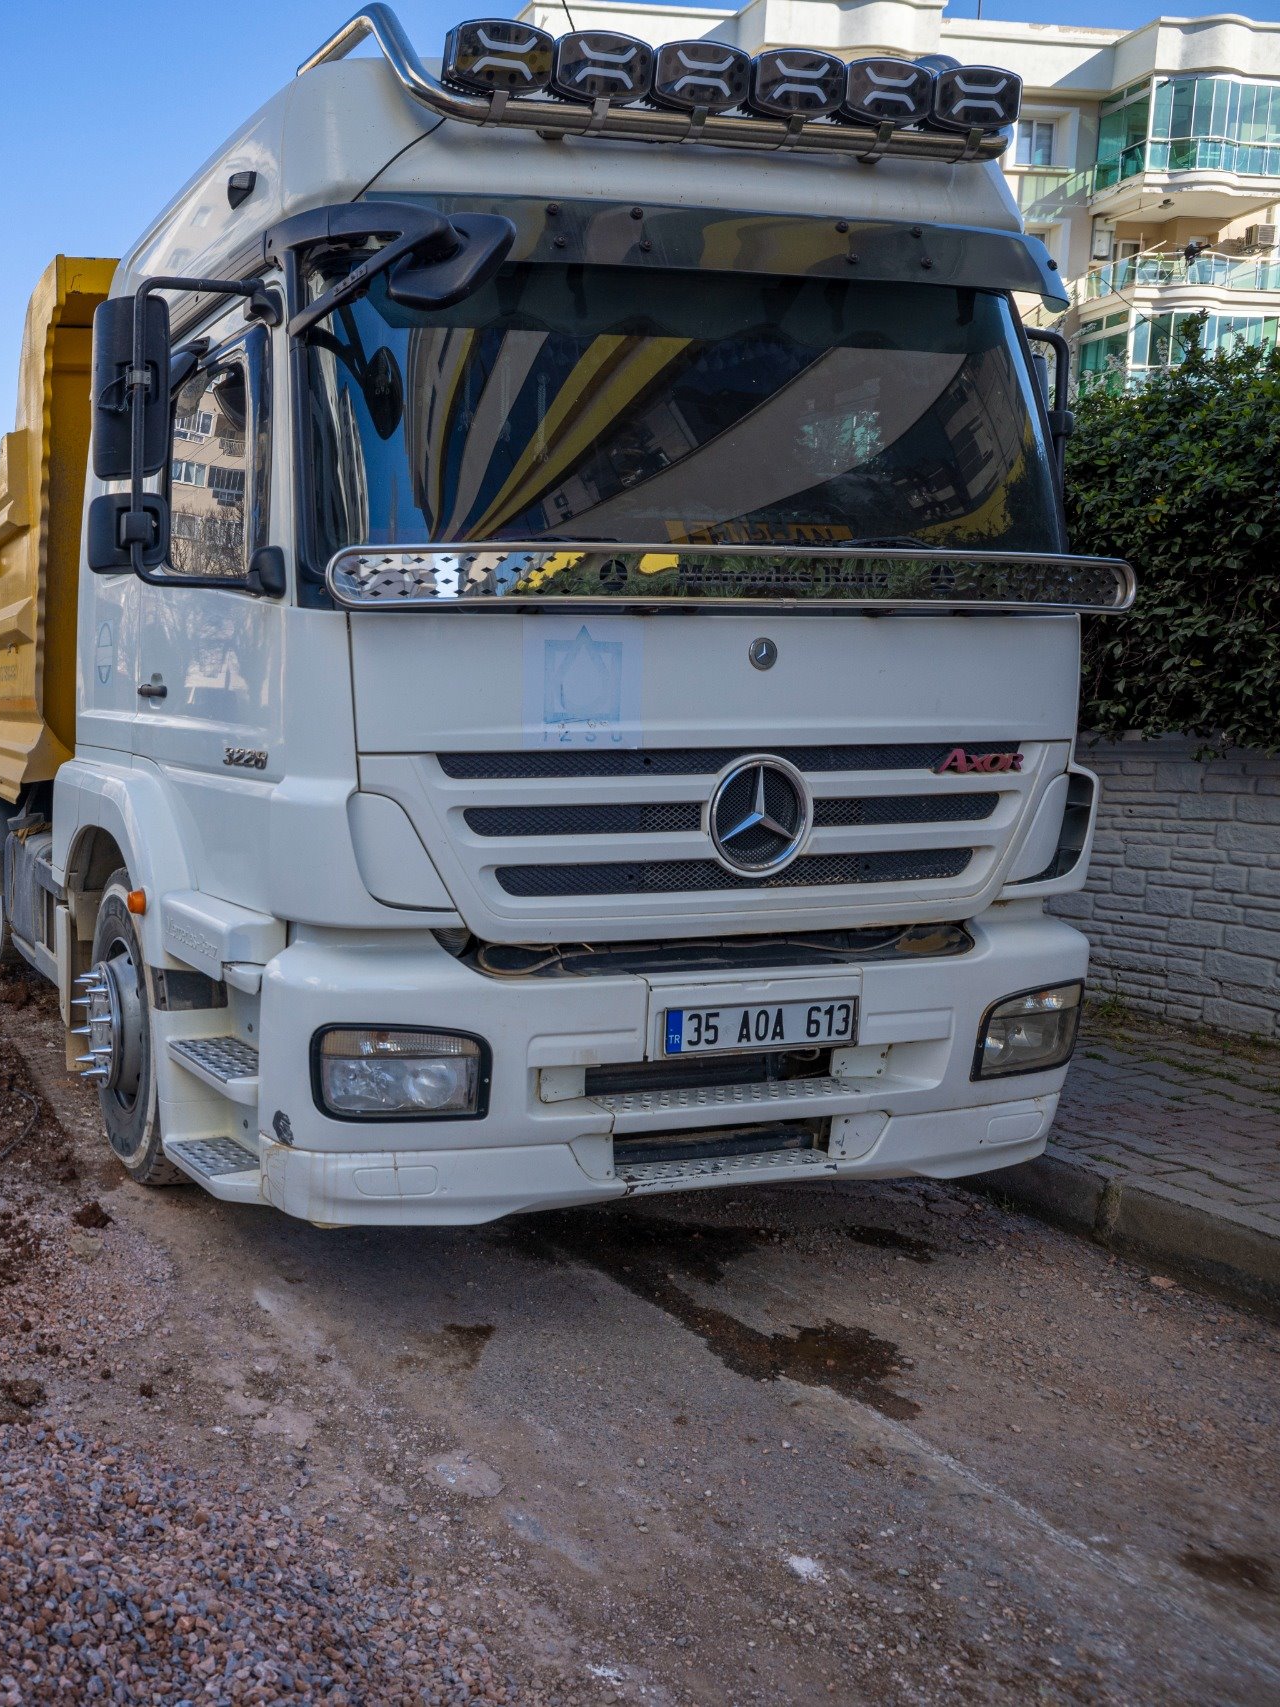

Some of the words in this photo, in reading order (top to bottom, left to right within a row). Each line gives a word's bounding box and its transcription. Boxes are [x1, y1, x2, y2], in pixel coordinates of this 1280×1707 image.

[677, 563, 889, 590] Mercedes-Benz
[222, 747, 269, 770] 3228
[687, 1011, 720, 1046] 35
[805, 1002, 851, 1038] 613
[668, 1034, 681, 1044] TR
